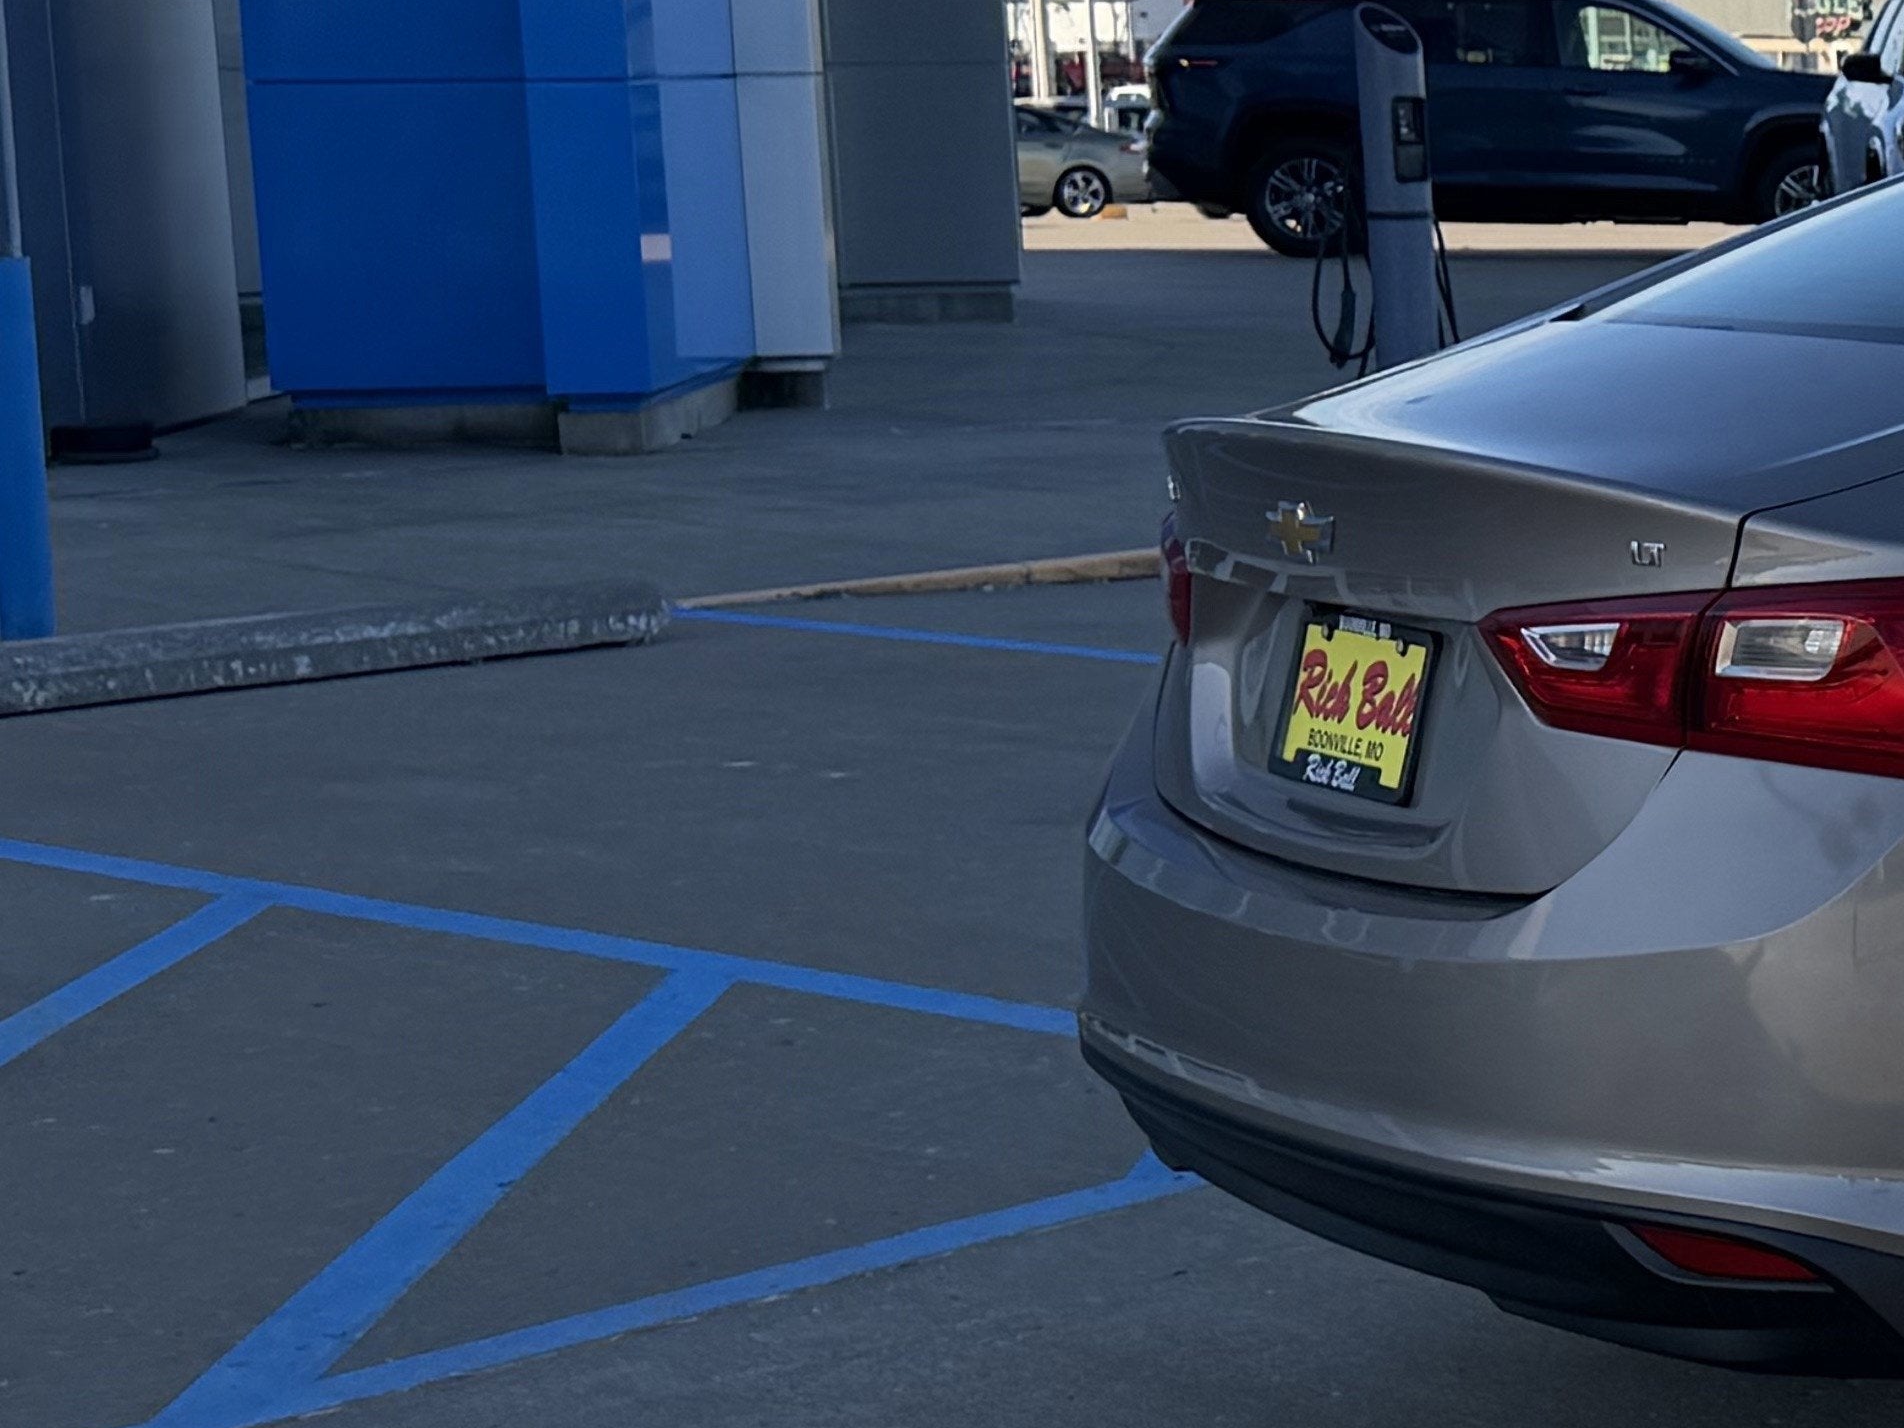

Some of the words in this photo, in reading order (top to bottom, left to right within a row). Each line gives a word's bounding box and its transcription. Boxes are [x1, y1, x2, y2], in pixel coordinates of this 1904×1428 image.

[1293, 648, 1358, 723] Rick
[1356, 660, 1418, 737] Ball
[1307, 728, 1362, 759] BOONVILLE,
[1365, 739, 1384, 761] MO
